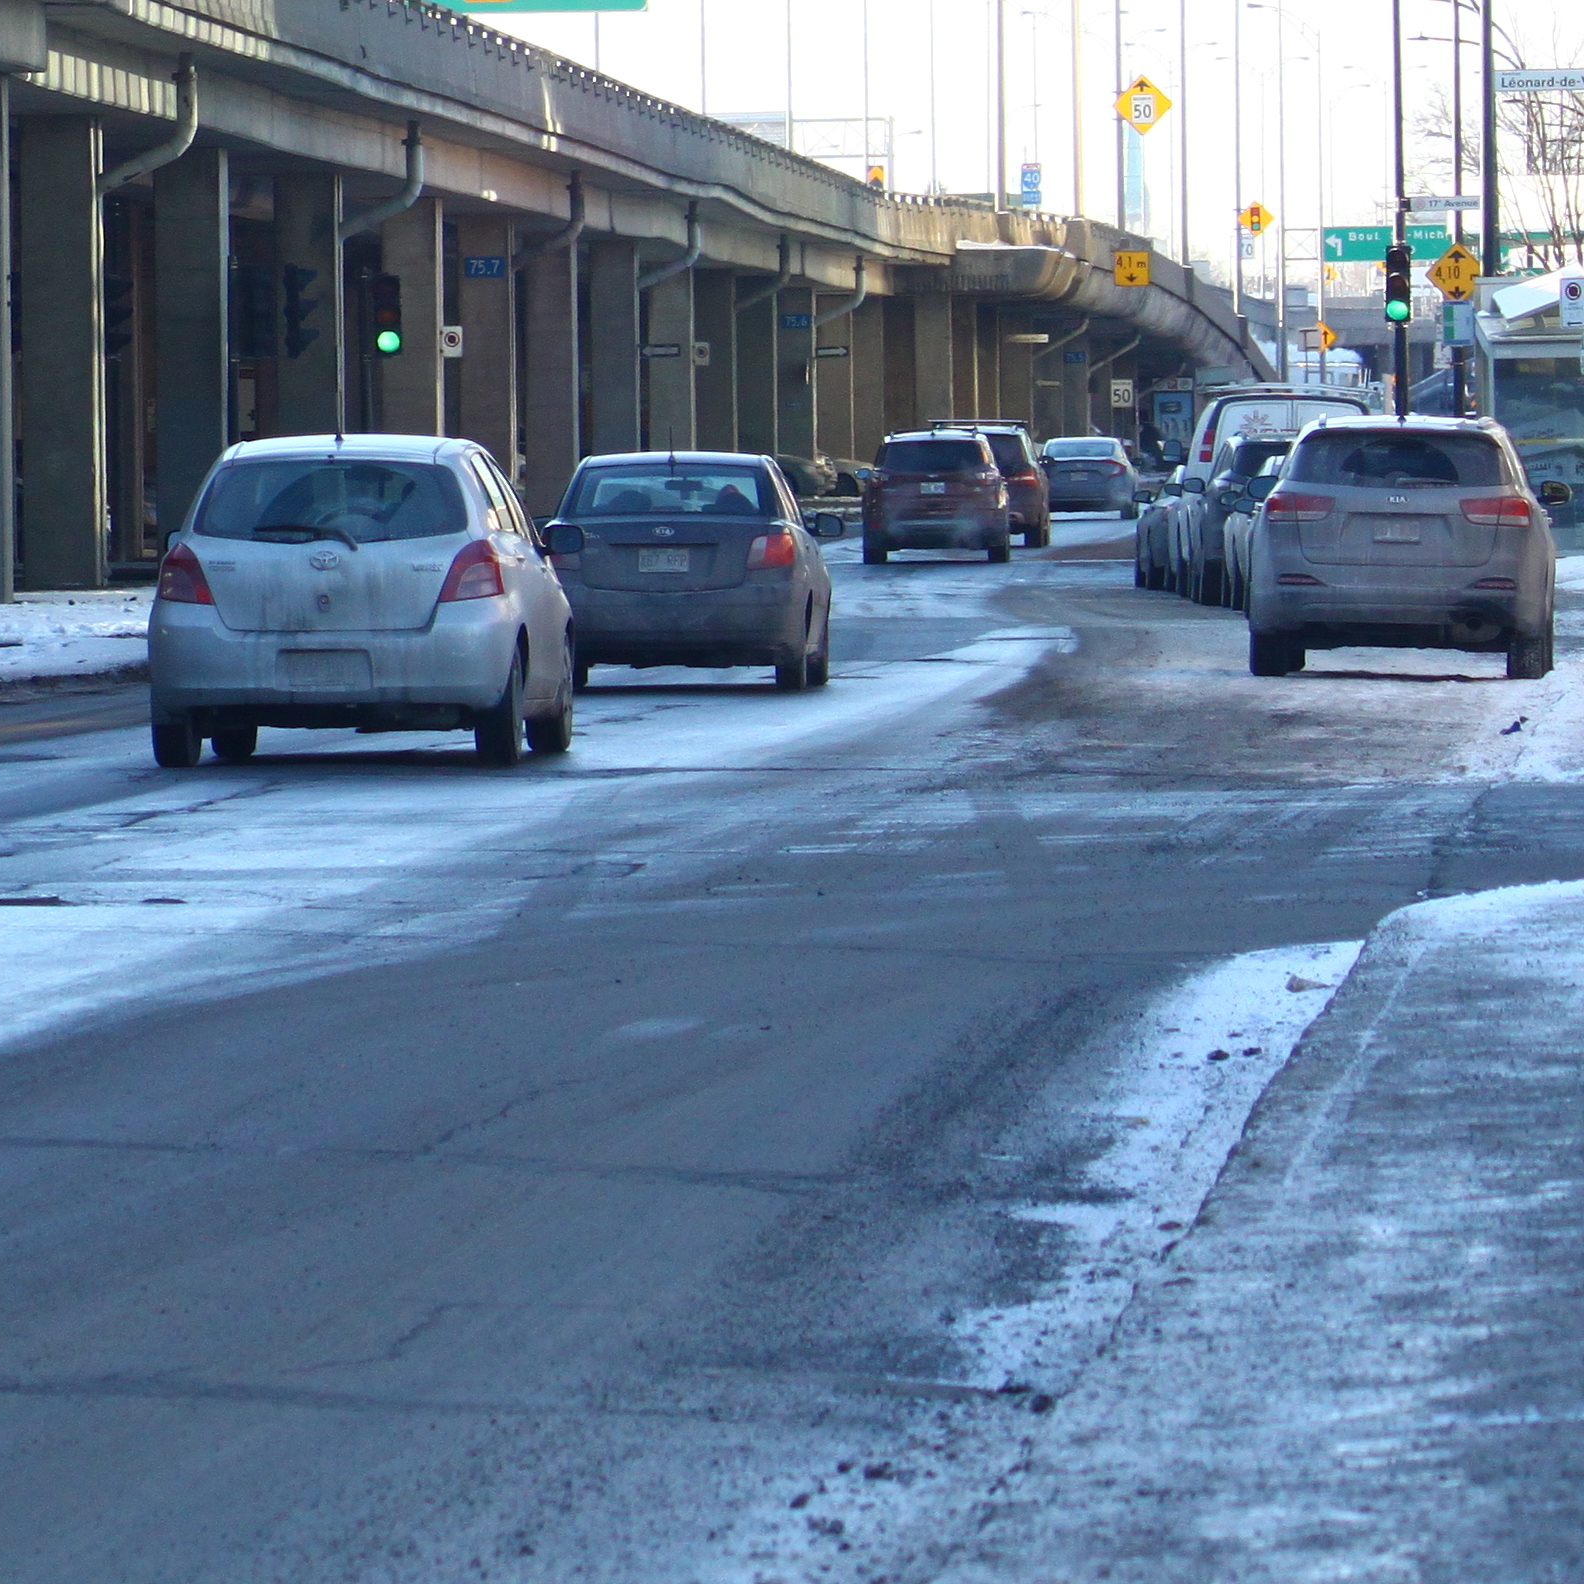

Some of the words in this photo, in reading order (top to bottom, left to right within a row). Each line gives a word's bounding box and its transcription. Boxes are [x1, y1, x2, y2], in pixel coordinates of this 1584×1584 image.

[1134, 104, 1152, 118] 50
[1024, 172, 1039, 183] 40
[1444, 199, 1478, 208] Avenue
[1137, 261, 1147, 269] m
[1113, 389, 1131, 403] 50
